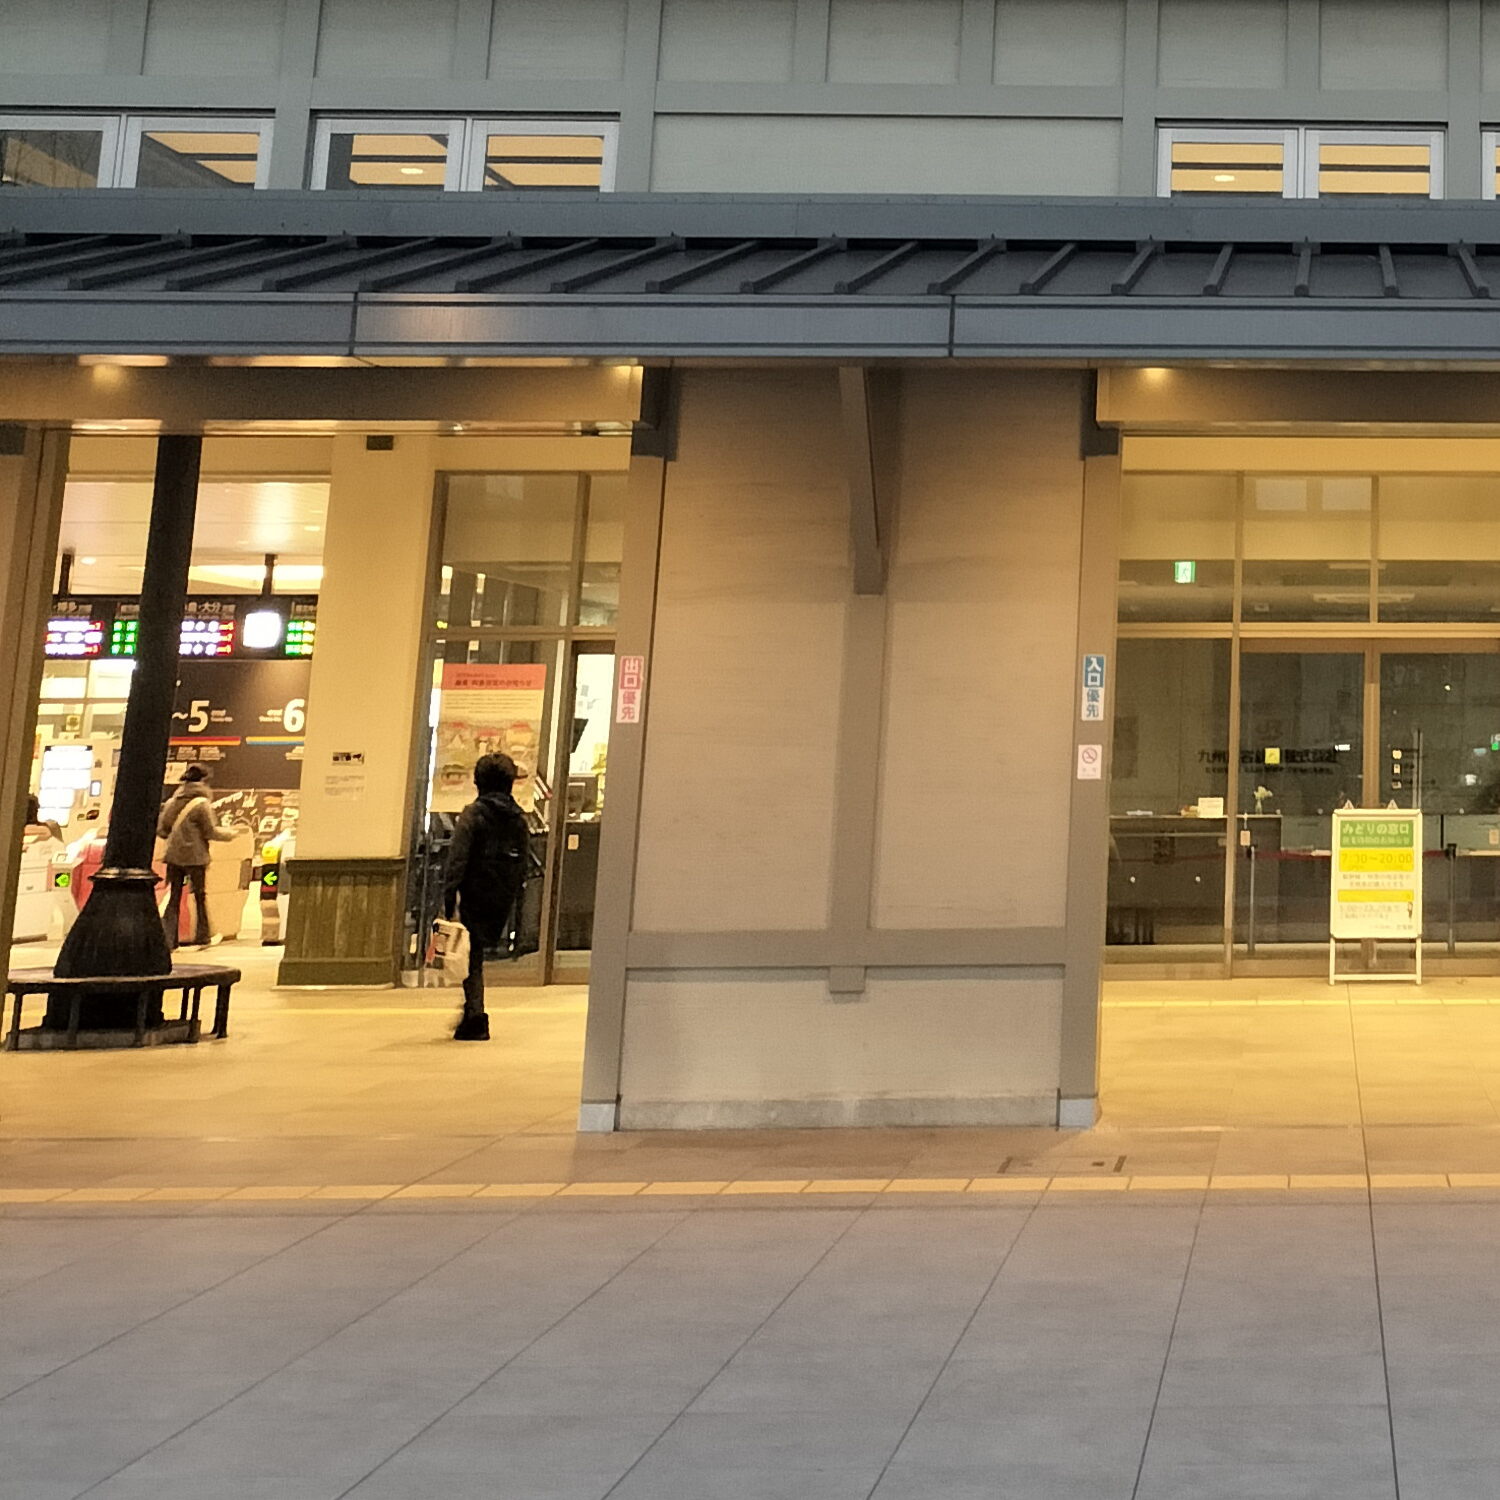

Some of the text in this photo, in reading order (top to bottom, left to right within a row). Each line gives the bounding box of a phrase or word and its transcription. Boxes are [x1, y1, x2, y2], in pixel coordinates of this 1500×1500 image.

[620, 659, 639, 720] 出口優先
[1086, 657, 1101, 718] 入口優先
[1342, 823, 1410, 835] みどりの窓口
